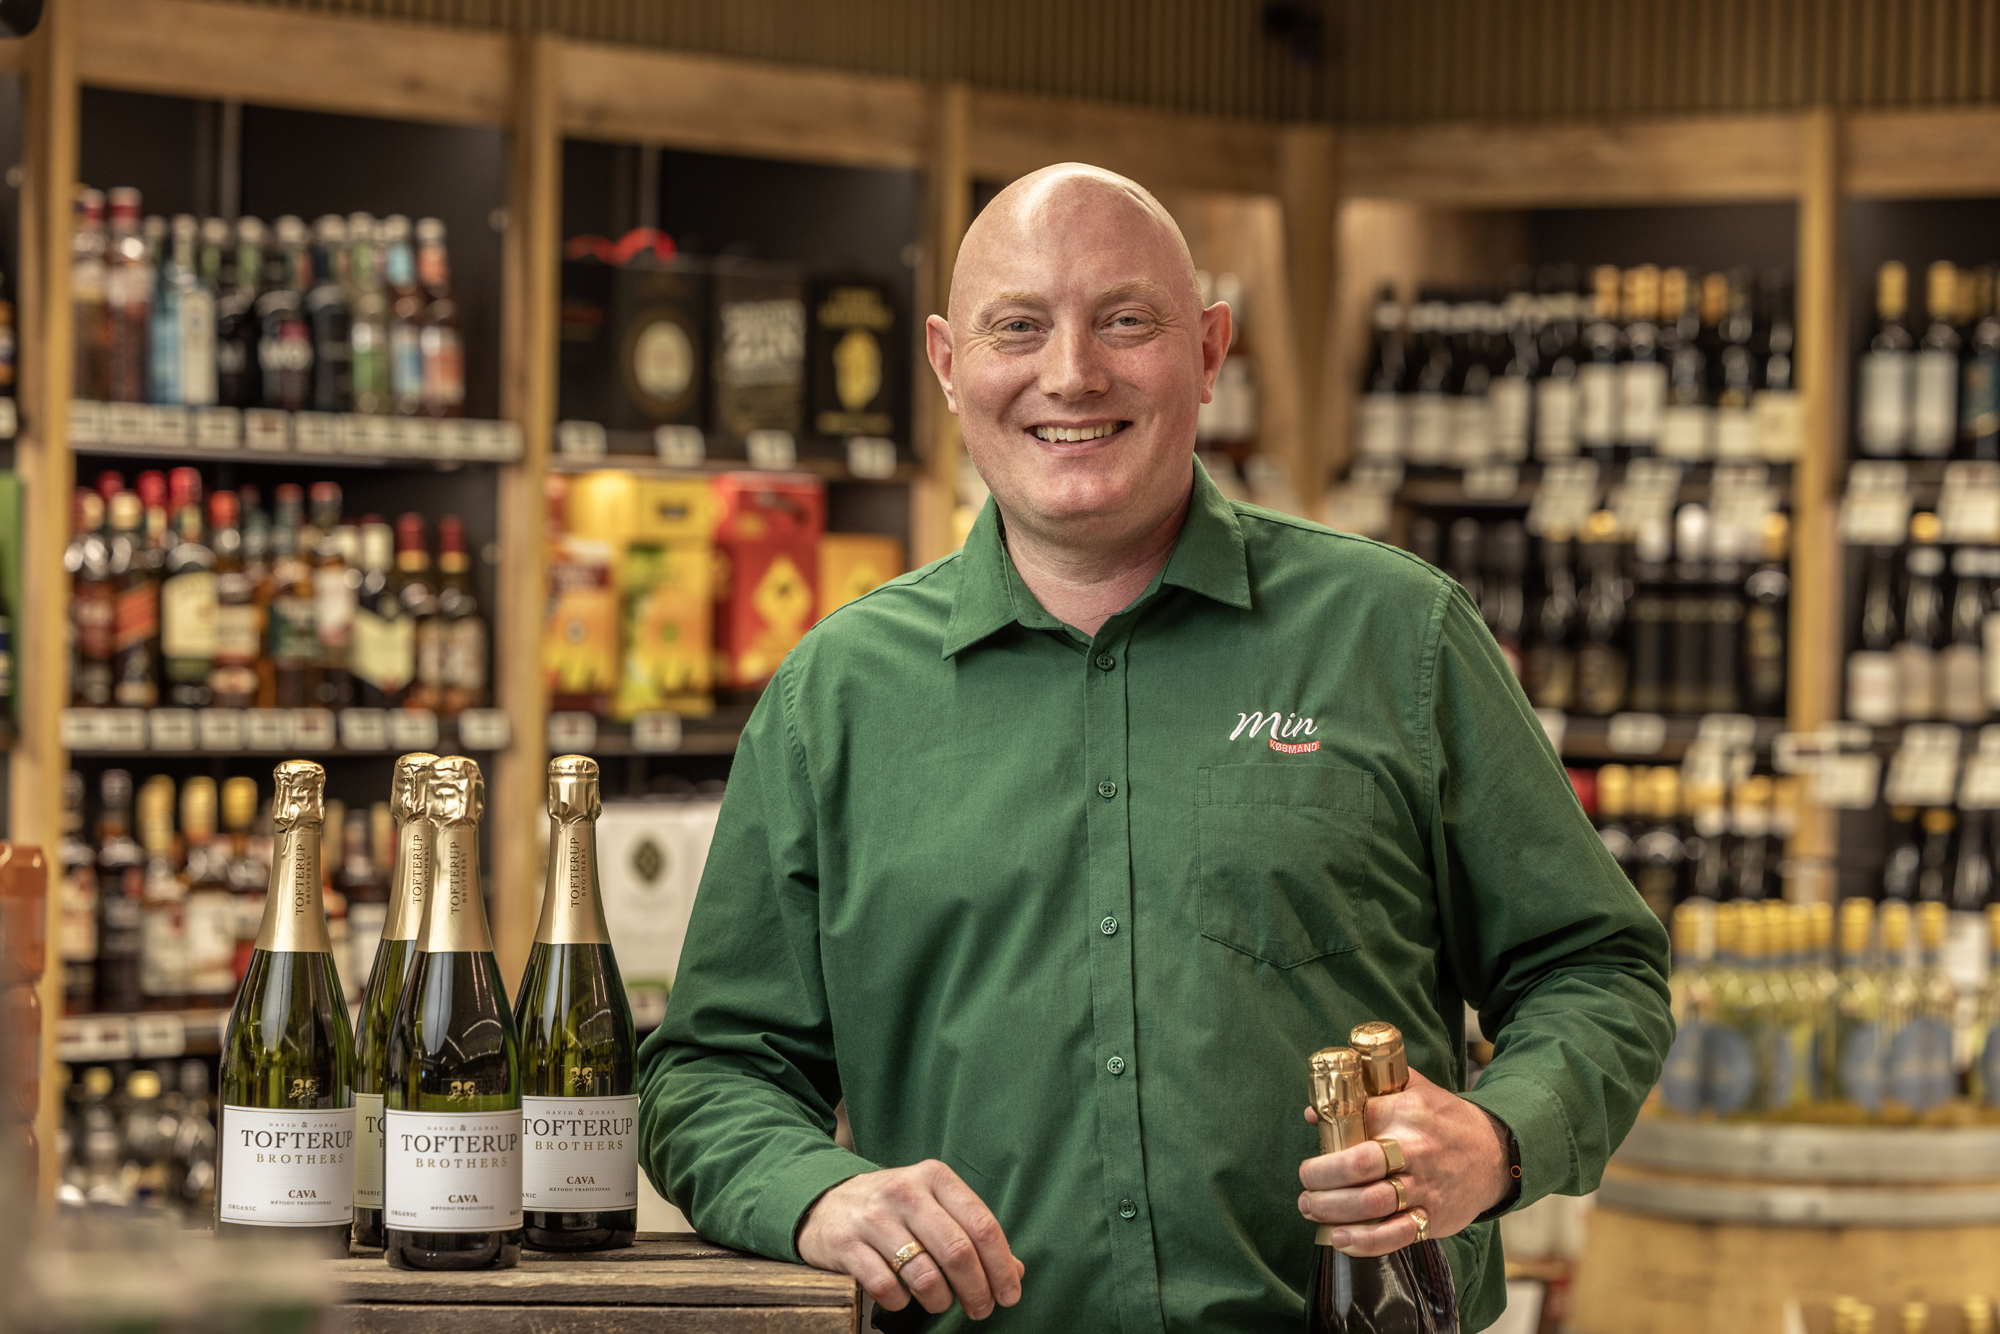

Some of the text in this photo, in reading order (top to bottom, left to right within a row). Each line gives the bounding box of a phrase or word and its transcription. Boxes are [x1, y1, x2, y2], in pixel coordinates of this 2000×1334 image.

[1229, 711, 1318, 741] Min
[1270, 740, 1318, 754] KØBMAND
[413, 834, 423, 904] TOFTERUP
[570, 837, 580, 908] TOFTERUP
[295, 843, 305, 916] TOFTERUP
[450, 841, 460, 915] TOFTERUP
[577, 1108, 585, 1116] &
[301, 1120, 309, 1128] &
[459, 1124, 467, 1132] &
[522, 1117, 633, 1137] TOFTERUP
[241, 1129, 353, 1149] TOFTERUP
[401, 1133, 518, 1153] TOFTERUP
[535, 1140, 623, 1151] BROTHERS
[256, 1153, 344, 1165] BROTHERS
[416, 1157, 508, 1169] BROTHERS
[566, 1175, 595, 1185] CAVA
[288, 1190, 317, 1199] CAVA
[357, 1189, 382, 1197] ORGANIC
[448, 1194, 479, 1204] CAVA
[228, 1203, 257, 1212] ORGANIC
[391, 1209, 418, 1218] ORGANIC
